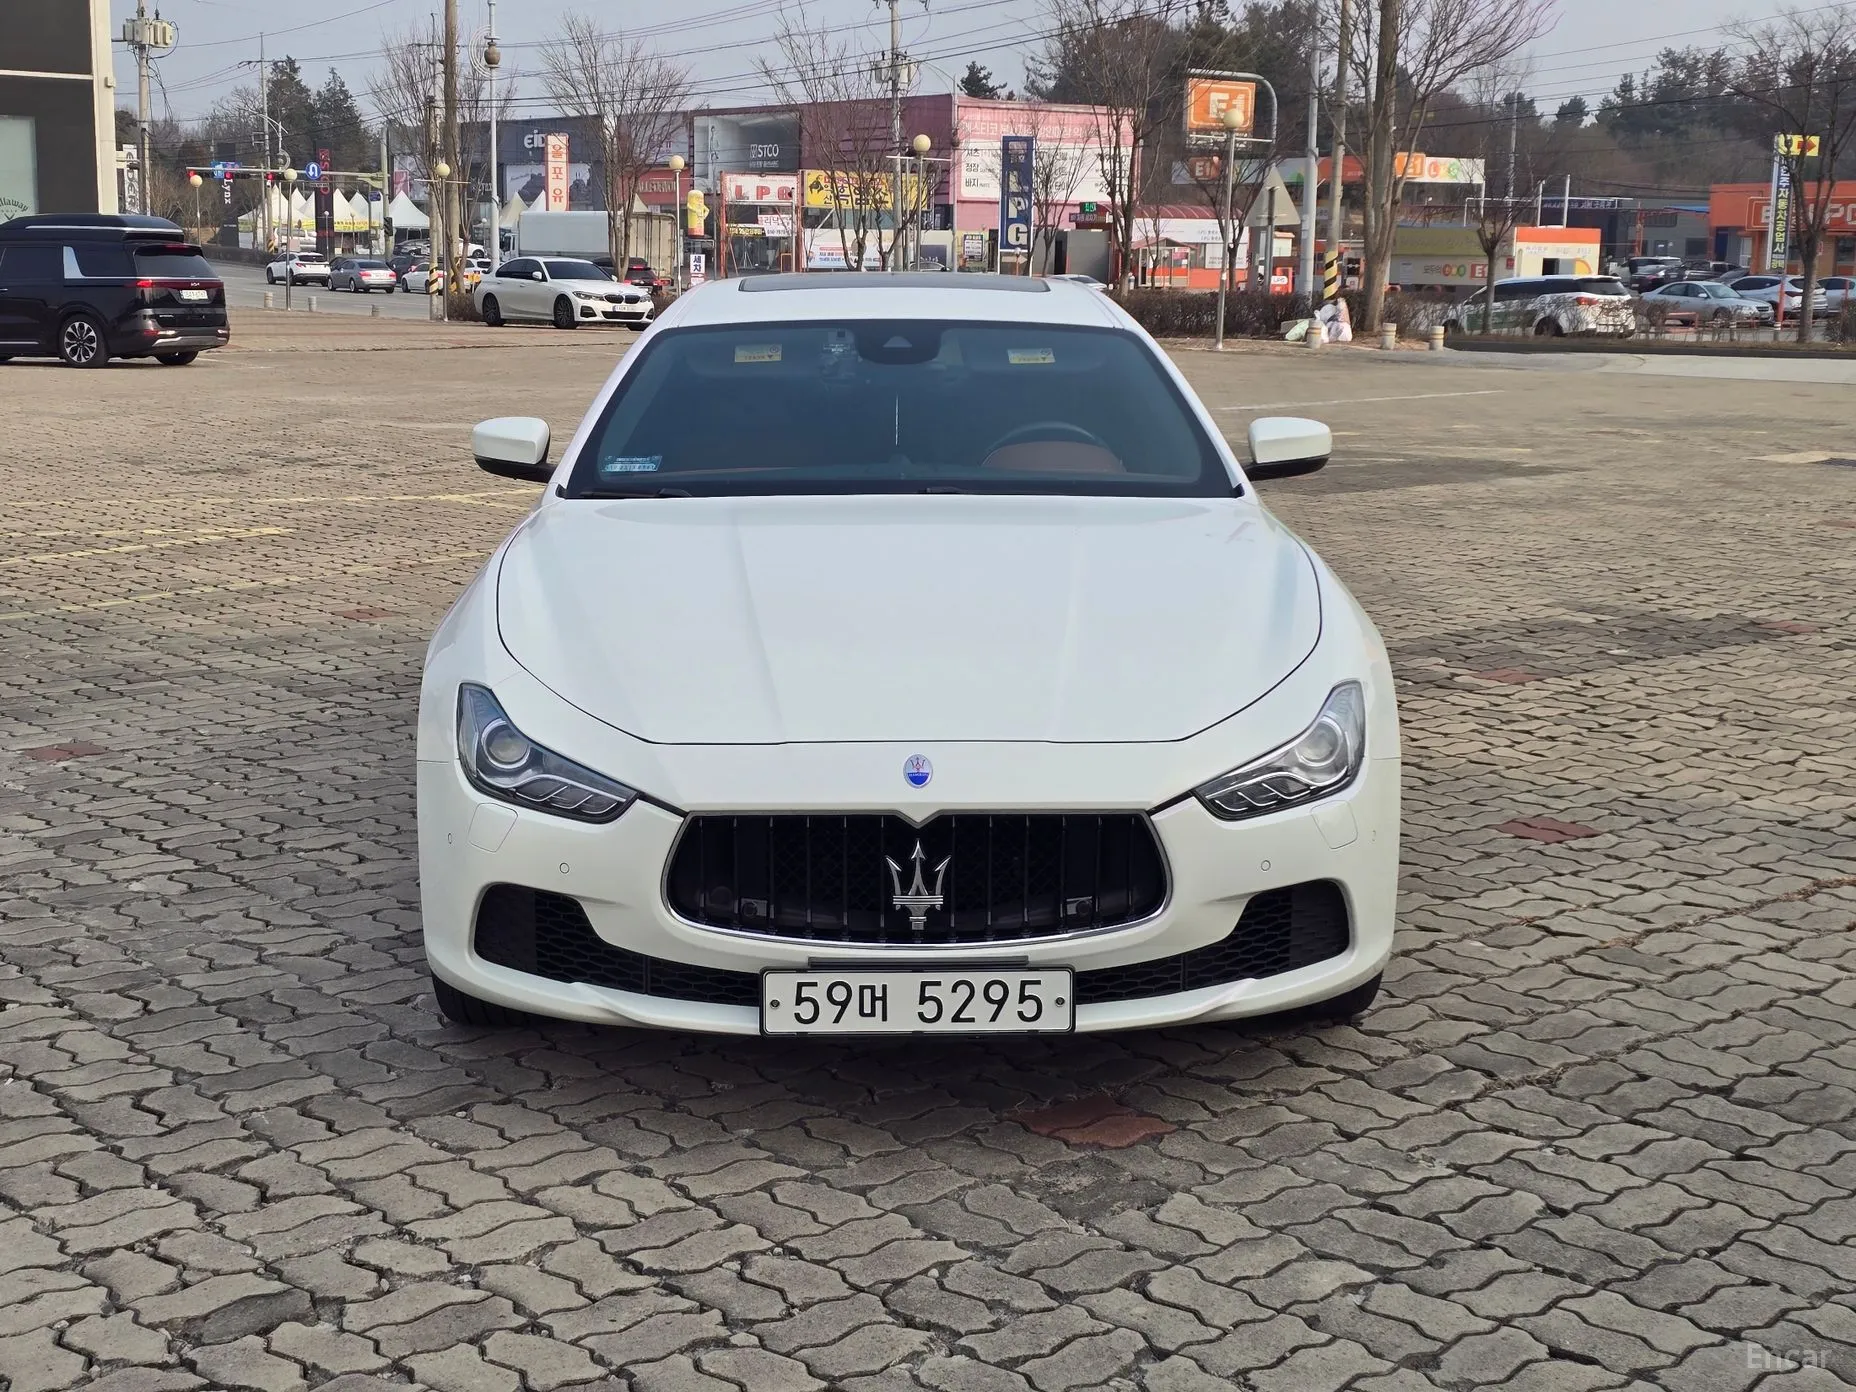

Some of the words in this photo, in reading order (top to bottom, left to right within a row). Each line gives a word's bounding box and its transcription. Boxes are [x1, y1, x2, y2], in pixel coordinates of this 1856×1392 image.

[1209, 92, 1246, 118] E1
[757, 144, 779, 158] STCO
[551, 143, 564, 203] 올포유
[965, 163, 979, 173] 정장
[222, 178, 235, 205] Lynx
[965, 178, 979, 188] 바지
[693, 255, 702, 272] 세차
[794, 980, 888, 1025] 59머
[917, 979, 1043, 1024] 5295
